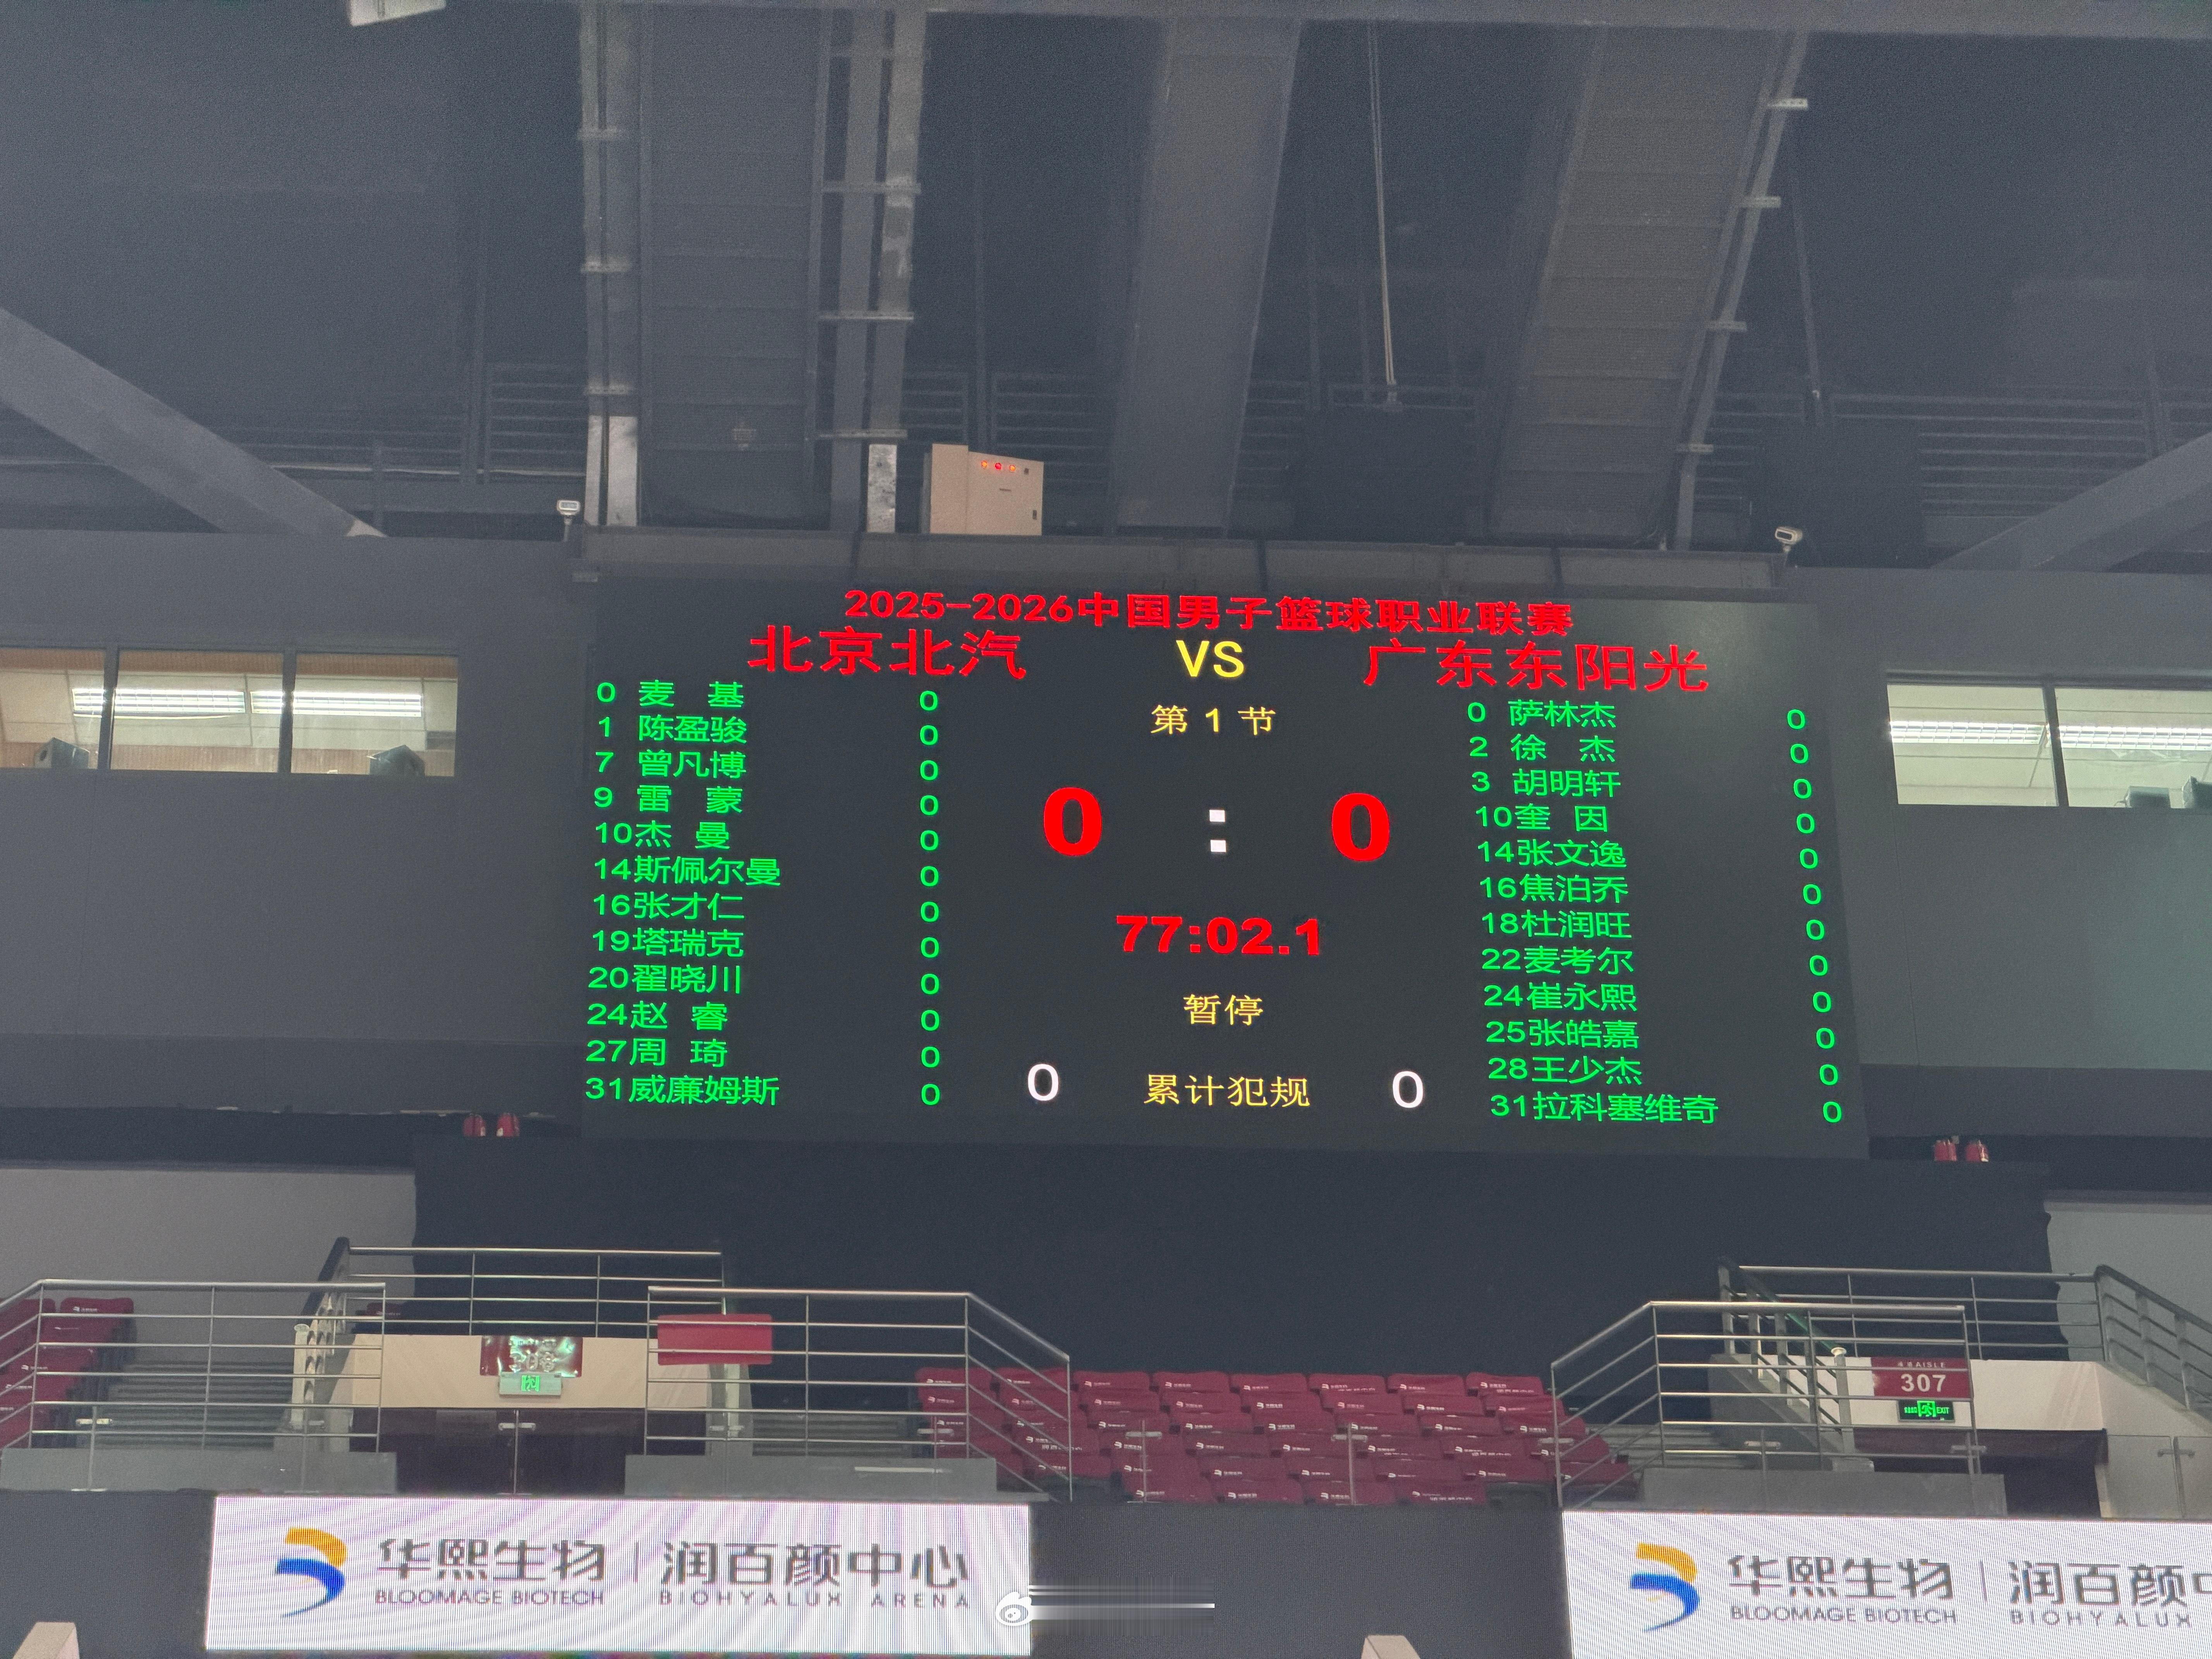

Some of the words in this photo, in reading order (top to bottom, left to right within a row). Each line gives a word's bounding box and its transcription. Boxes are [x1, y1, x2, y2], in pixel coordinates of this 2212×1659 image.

[845, 590, 1573, 636] 2025-2026中国男子篮球职业联赛
[748, 625, 1026, 679] 北京北汽
[1176, 640, 1245, 678] VS
[1364, 638, 1709, 692] 广东东阳光
[596, 682, 617, 704] 0
[639, 679, 675, 708] 麦
[708, 681, 745, 709] 基
[919, 690, 939, 712] 0
[1152, 706, 1187, 734] 第
[1206, 709, 1219, 732] 1
[1239, 707, 1275, 735] 节
[1467, 702, 1487, 723] 0
[1508, 699, 1616, 729] 萨林杰
[1786, 709, 1807, 730] 0
[599, 716, 611, 738] 1
[638, 714, 747, 744] 陈盈骏
[919, 725, 939, 746] 0
[1470, 736, 1489, 758] 2
[1511, 733, 1547, 762] 徐
[1580, 735, 1616, 763] 杰
[1790, 743, 1810, 764] 0
[596, 751, 615, 773] 7
[638, 749, 747, 781] 曾凡博
[919, 760, 939, 781] 0
[1472, 771, 1491, 793] 3
[1512, 768, 1621, 798] 胡明轩
[1793, 778, 1813, 800] 0
[594, 787, 614, 809] 9
[637, 784, 673, 814] 雷
[706, 785, 744, 815] 蒙
[920, 795, 940, 816] 0
[1043, 787, 1102, 856] 0
[1331, 793, 1390, 861] 0
[1574, 805, 1608, 833] 因
[1796, 813, 1816, 835] 0
[696, 821, 730, 851] 曼
[920, 830, 940, 852] 0
[1799, 848, 1819, 870] 0
[920, 866, 940, 888] 0
[1802, 884, 1822, 905] 0
[920, 901, 940, 923] 0
[1116, 915, 1319, 956] 77:02.1
[1805, 919, 1826, 941] 0
[920, 936, 940, 959] 0
[1809, 955, 1829, 977] 0
[920, 973, 940, 996] 0
[691, 1001, 728, 1032] 睿
[921, 1009, 941, 1032] 0
[1184, 994, 1263, 1026] 暂停
[1812, 991, 1832, 1013] 0
[690, 1038, 728, 1068] 琦
[921, 1046, 941, 1068] 0
[1816, 1027, 1836, 1049] 0
[1028, 1064, 1058, 1101] 0
[1146, 1075, 1310, 1107] 累计犯规
[1393, 1071, 1423, 1108] 0
[1819, 1064, 1839, 1086] 0
[921, 1084, 941, 1106] 0
[1823, 1101, 1843, 1123] 0
[1901, 1374, 1946, 1392] 307
[378, 1538, 605, 1581] 华熙生物
[661, 1540, 969, 1589] 润百颜中心
[1727, 1555, 1954, 1600] 华熙生物
[375, 1590, 503, 1605] BLOOMAGE
[512, 1590, 604, 1605] BIOTECH
[659, 1590, 842, 1607] BIOHYALUX
[872, 1592, 970, 1608] ARENA
[1731, 1606, 1856, 1623] BLOOMAGE
[1865, 1607, 1956, 1624] BIOTECH
[2011, 1610, 2192, 1628] BIOHYALUX
